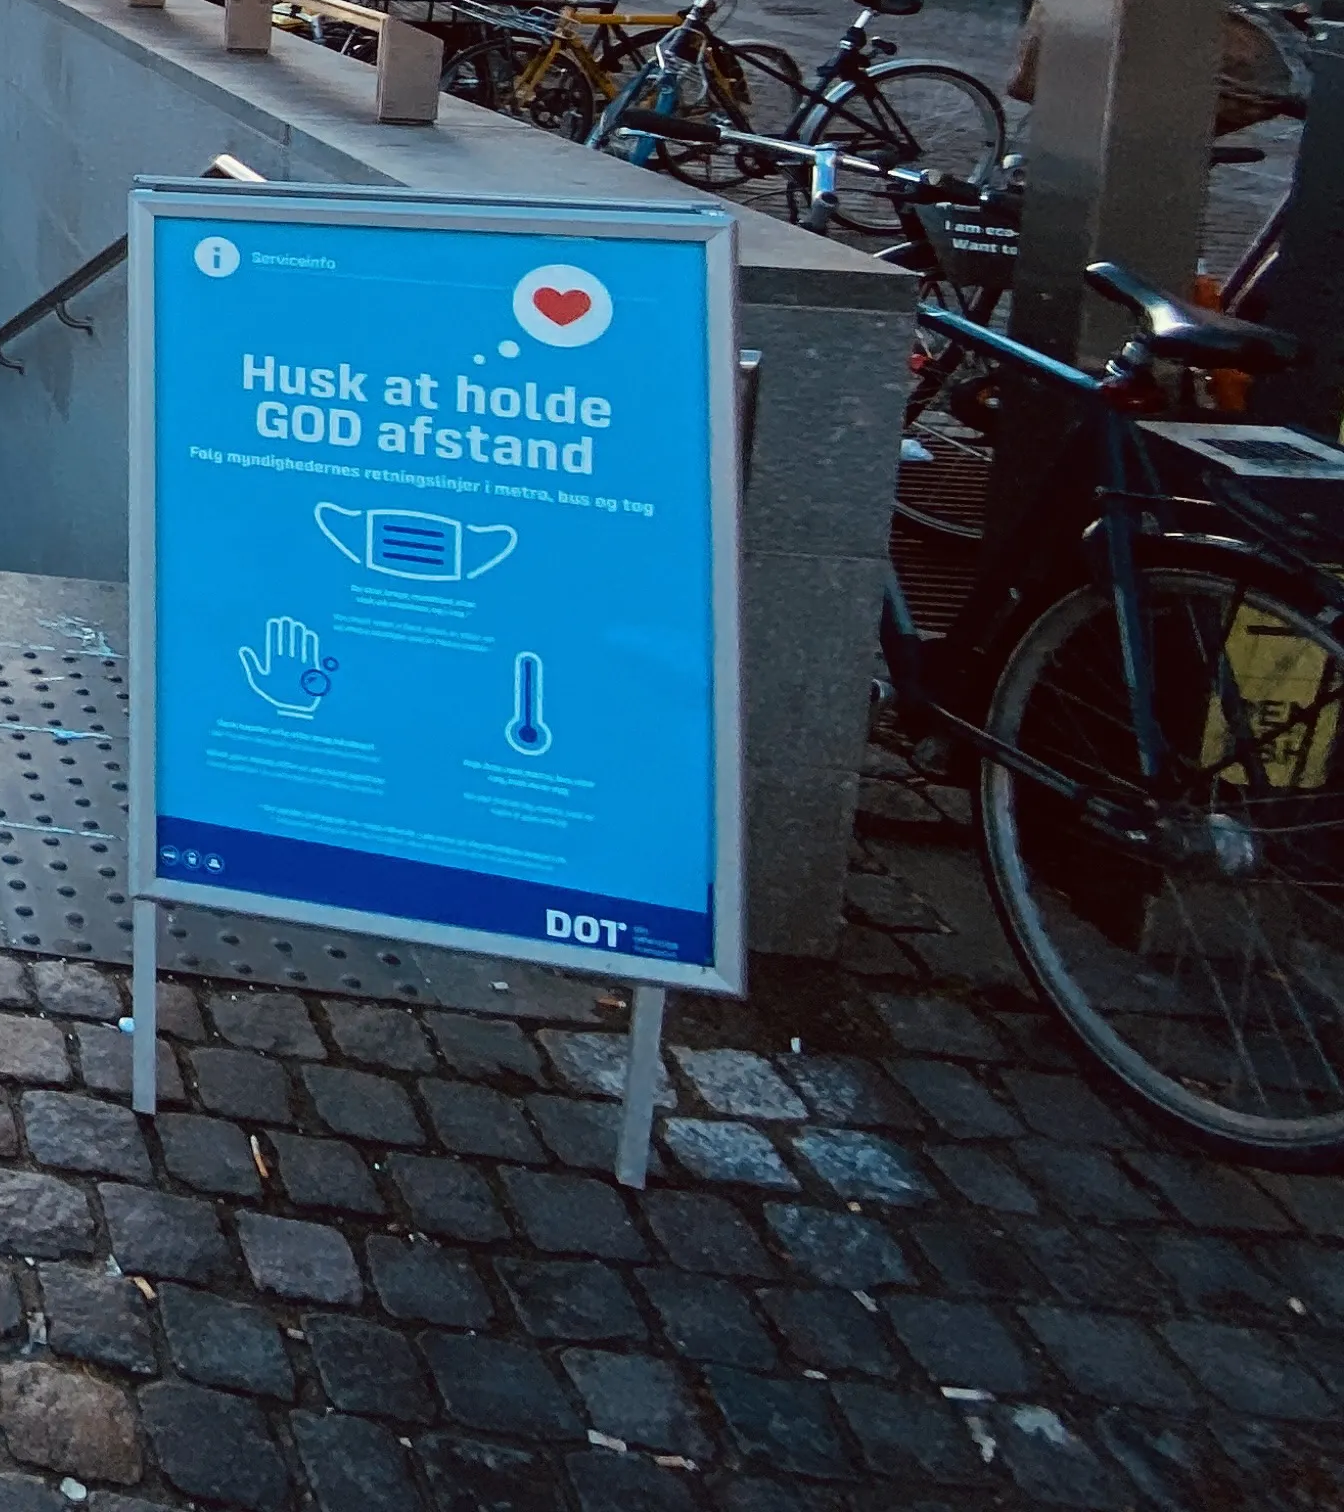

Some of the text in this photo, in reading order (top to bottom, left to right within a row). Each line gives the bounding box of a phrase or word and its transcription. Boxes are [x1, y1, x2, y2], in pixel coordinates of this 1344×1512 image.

[243, 354, 613, 429] Husk at holde
[256, 402, 593, 476] GOD afstand
[226, 452, 360, 478] myndighedernes
[364, 469, 481, 494] retningslinjer
[484, 480, 491, 494] i
[558, 490, 591, 507] bus
[595, 497, 618, 513] og
[546, 908, 627, 948] DOT
